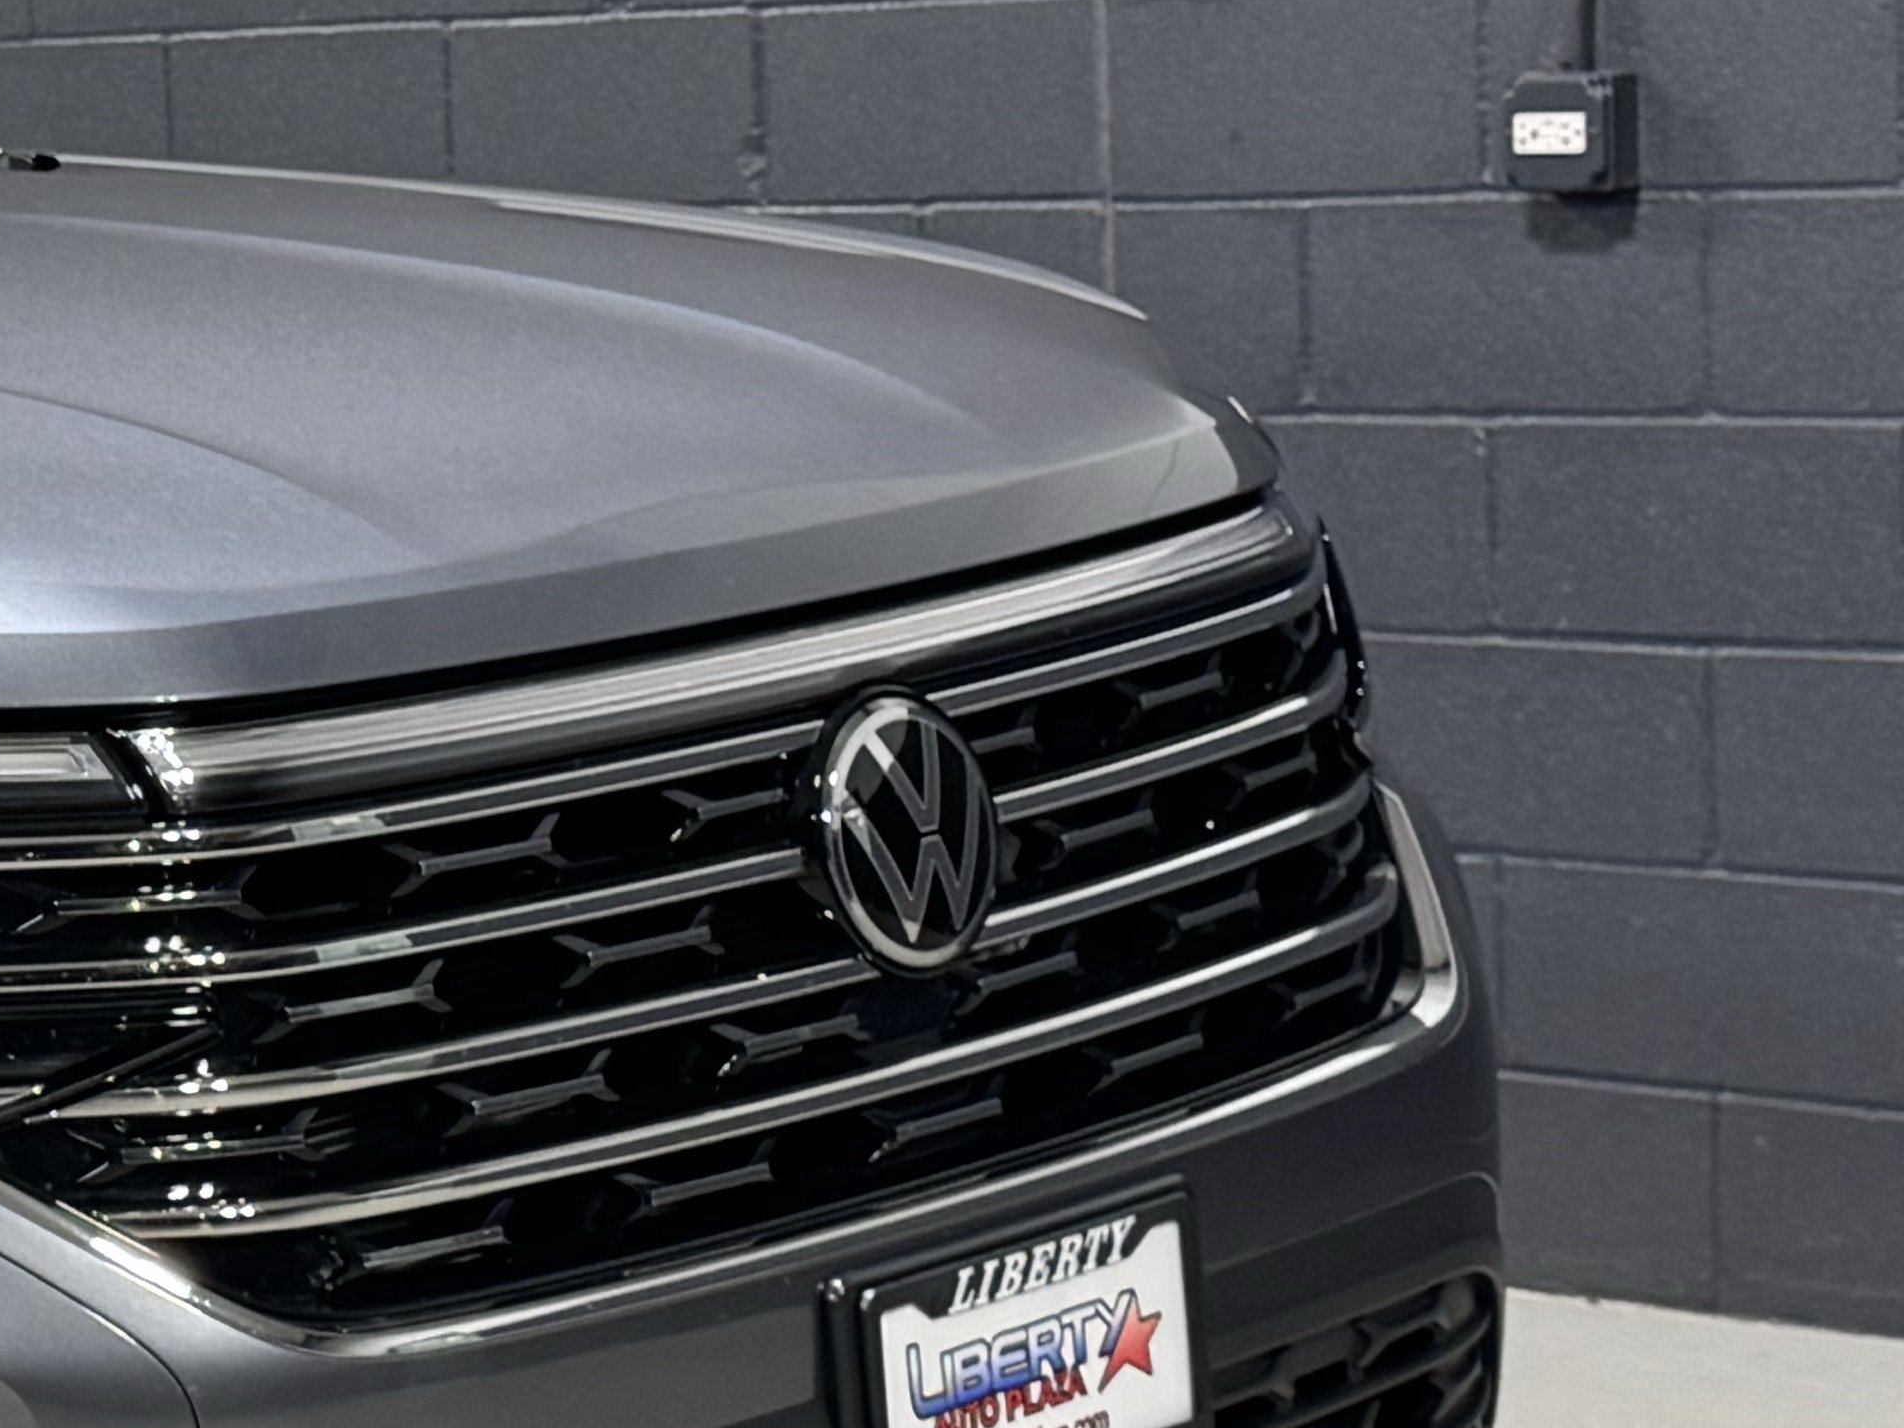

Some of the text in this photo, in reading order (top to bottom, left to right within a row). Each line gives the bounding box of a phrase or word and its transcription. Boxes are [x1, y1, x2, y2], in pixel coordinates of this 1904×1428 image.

[948, 1214, 1136, 1316] LIBERTY
[906, 1287, 1138, 1421] LIBERTY
[1005, 1365, 1088, 1423] PLAZA
